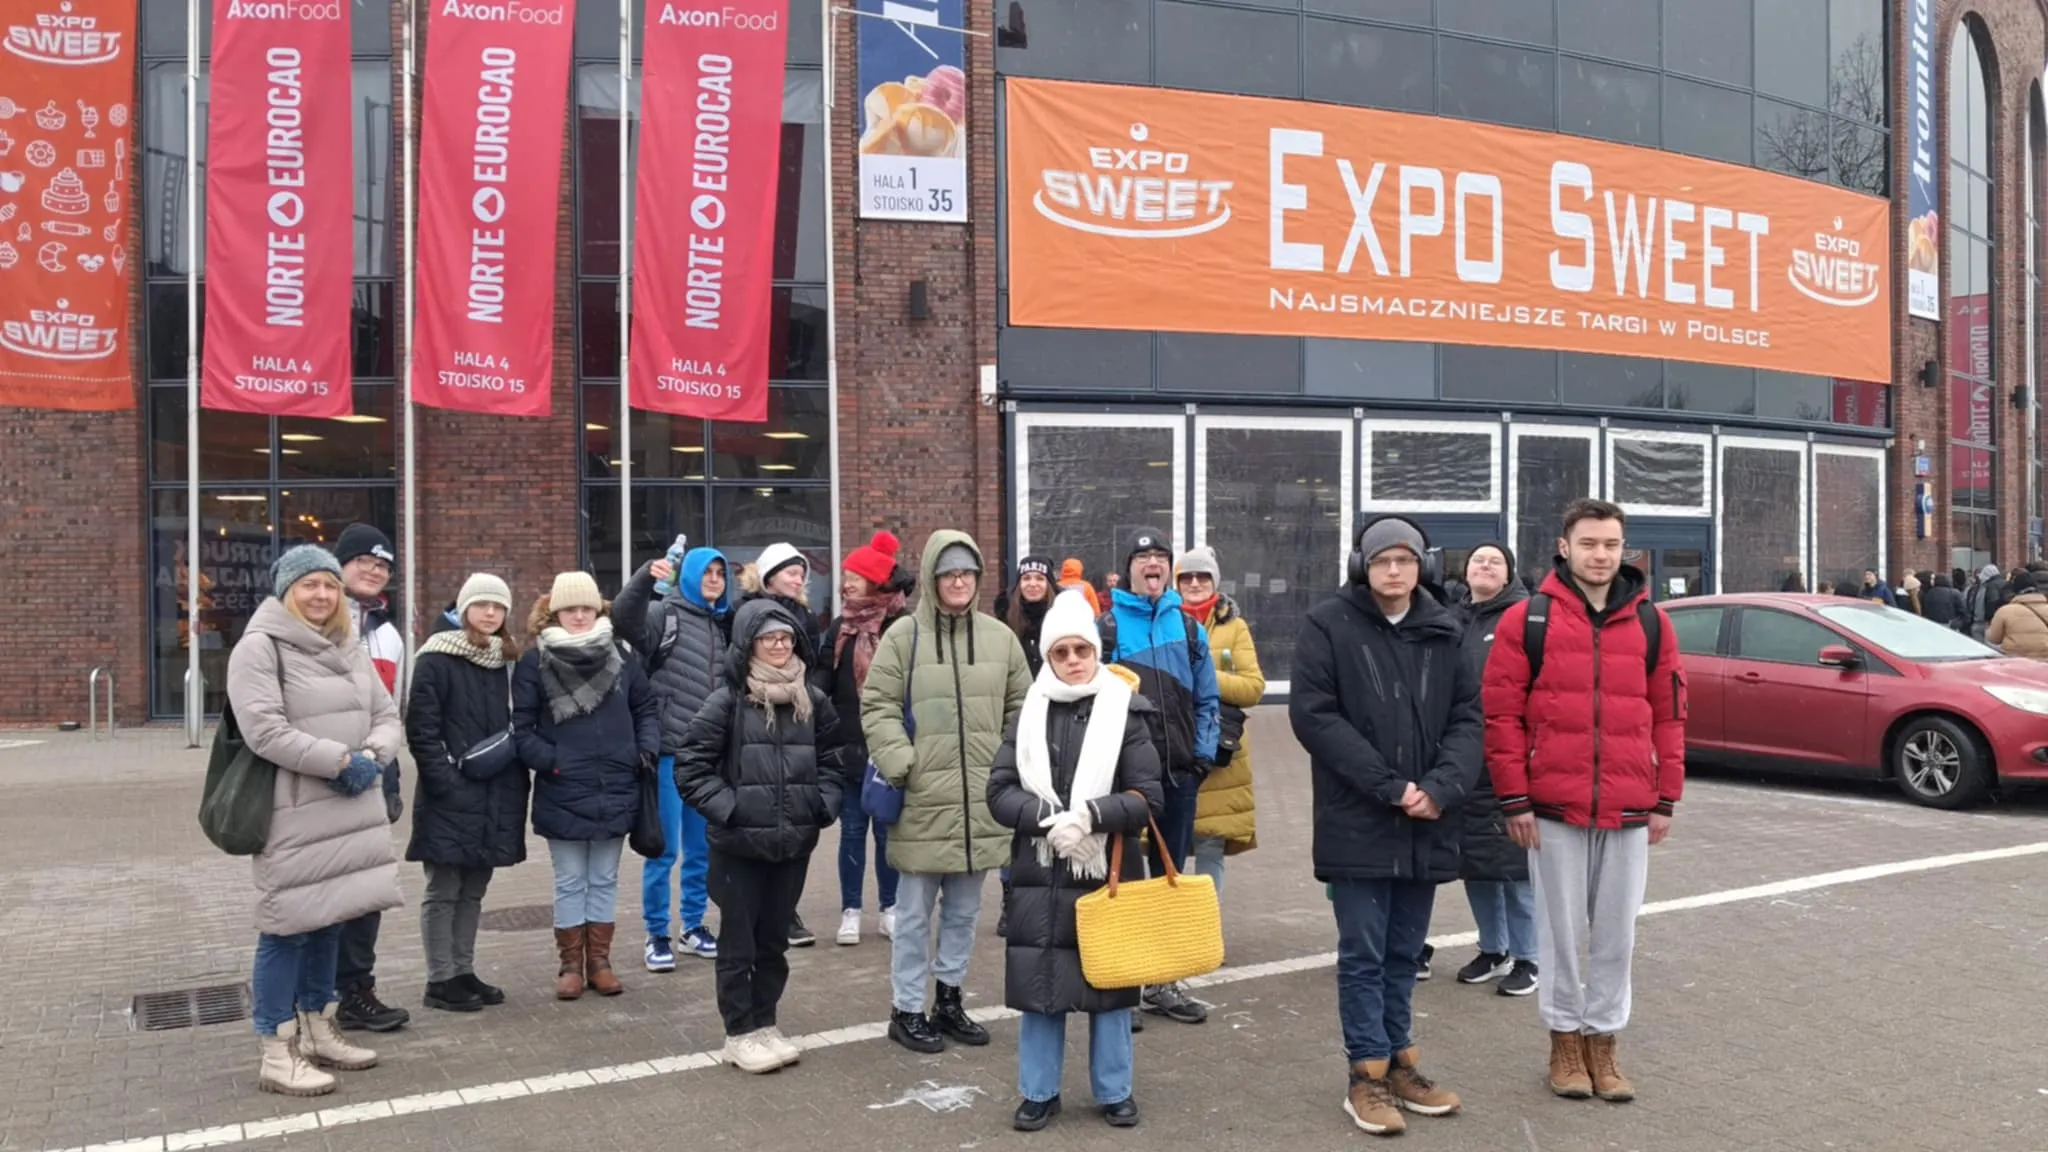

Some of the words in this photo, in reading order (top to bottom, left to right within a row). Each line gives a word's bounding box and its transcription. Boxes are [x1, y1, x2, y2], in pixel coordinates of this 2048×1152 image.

[36, 14, 97, 29] EXPO
[442, 0, 563, 25] AxonFood
[659, 3, 778, 31] AxonFood
[8, 26, 121, 56] SWEET
[266, 46, 305, 187] EUROCAO
[473, 46, 516, 182] EUROCAO
[692, 53, 733, 192] EUROCAO
[1089, 147, 1189, 173] EXPO
[873, 174, 905, 190] HALA
[909, 167, 917, 190] 1
[873, 195, 924, 213] STOISKO
[928, 188, 953, 212] 35
[1041, 168, 1234, 222] SWEET
[1269, 127, 1503, 284] EXPO
[1549, 160, 1770, 313] SWEET
[1814, 232, 1860, 257] EXPO
[265, 231, 305, 327] NORTE
[467, 228, 505, 323] NORTE
[685, 233, 724, 329] NORTE
[1791, 249, 1880, 294] SWEET
[29, 309, 96, 327] EXPO
[1577, 311, 1648, 334] TARGI
[3, 320, 118, 351] SWEET
[252, 355, 298, 373] HALA
[301, 361, 312, 374] 4
[453, 351, 496, 369] HALA
[499, 358, 510, 371] 4
[671, 357, 713, 376] HALA
[717, 363, 727, 377] 4
[235, 375, 307, 395] STOISKO
[312, 380, 329, 396] 15
[438, 370, 505, 391] STOISKO
[508, 378, 526, 394] 15
[657, 374, 722, 398] STOISKO
[726, 384, 742, 400] 15
